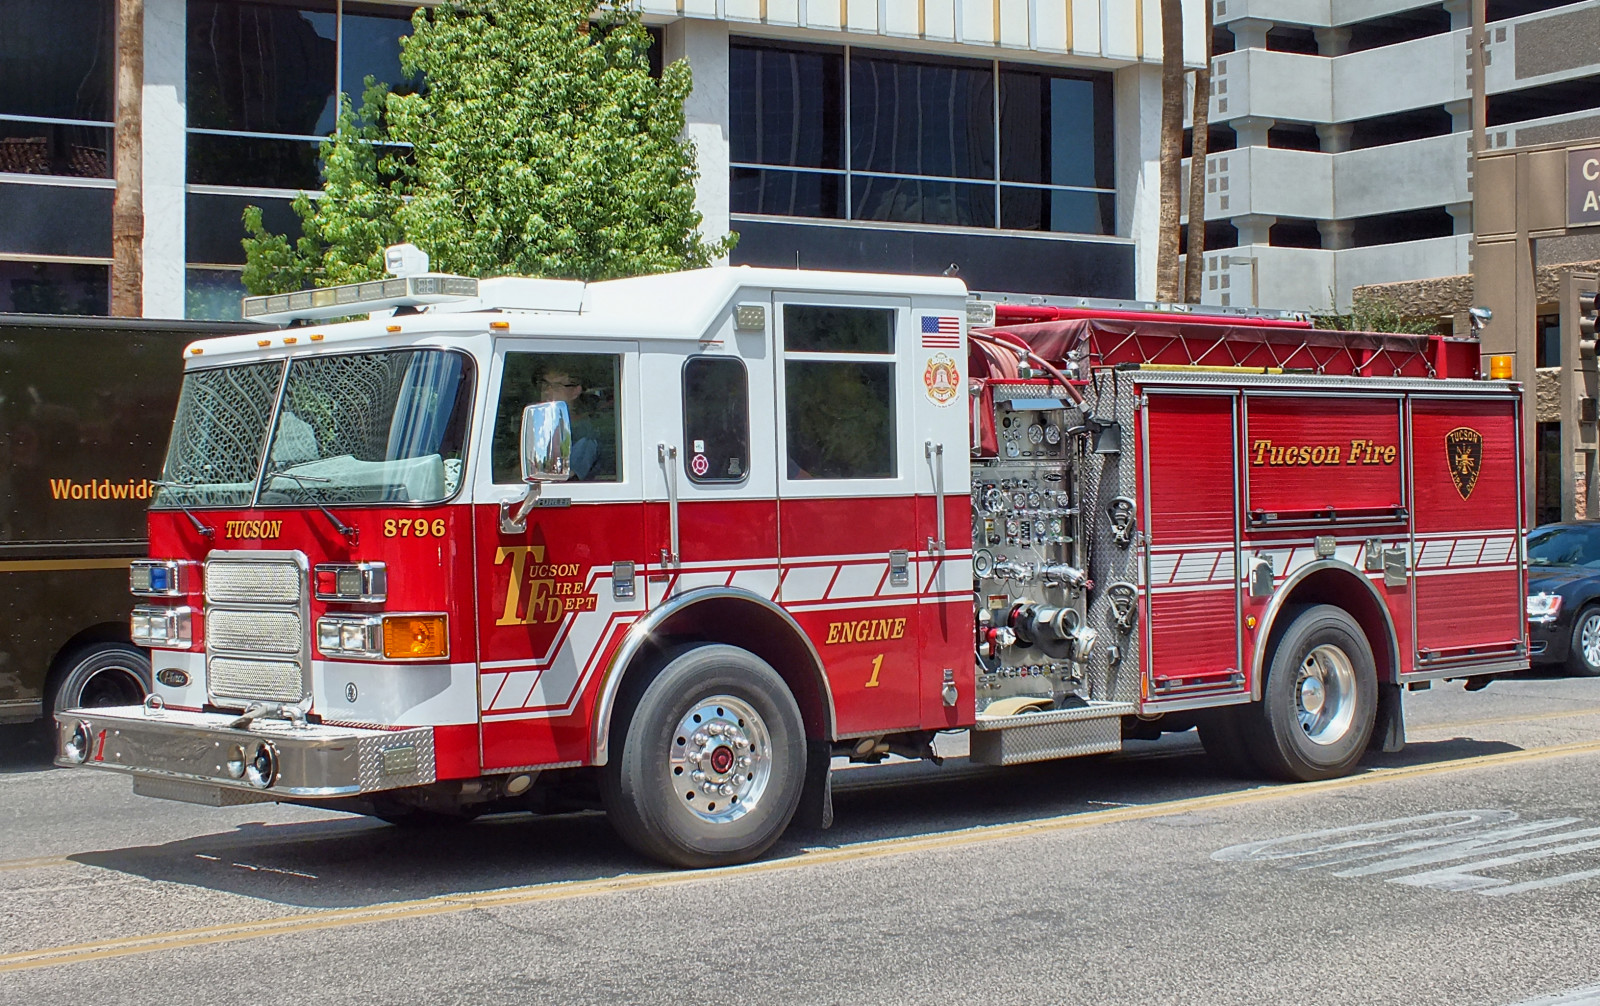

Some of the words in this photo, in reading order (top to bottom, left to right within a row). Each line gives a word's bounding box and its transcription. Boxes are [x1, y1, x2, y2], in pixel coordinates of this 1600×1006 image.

[1582, 190, 1600, 212] A
[1450, 430, 1478, 444] TUCSON
[1253, 439, 1341, 465] Tucson
[1346, 439, 1397, 465] Fire
[225, 520, 282, 539] TUCSON
[384, 518, 446, 537] 8796
[825, 617, 907, 645] ENGINE
[864, 653, 884, 688] 1
[94, 728, 107, 761] 1
